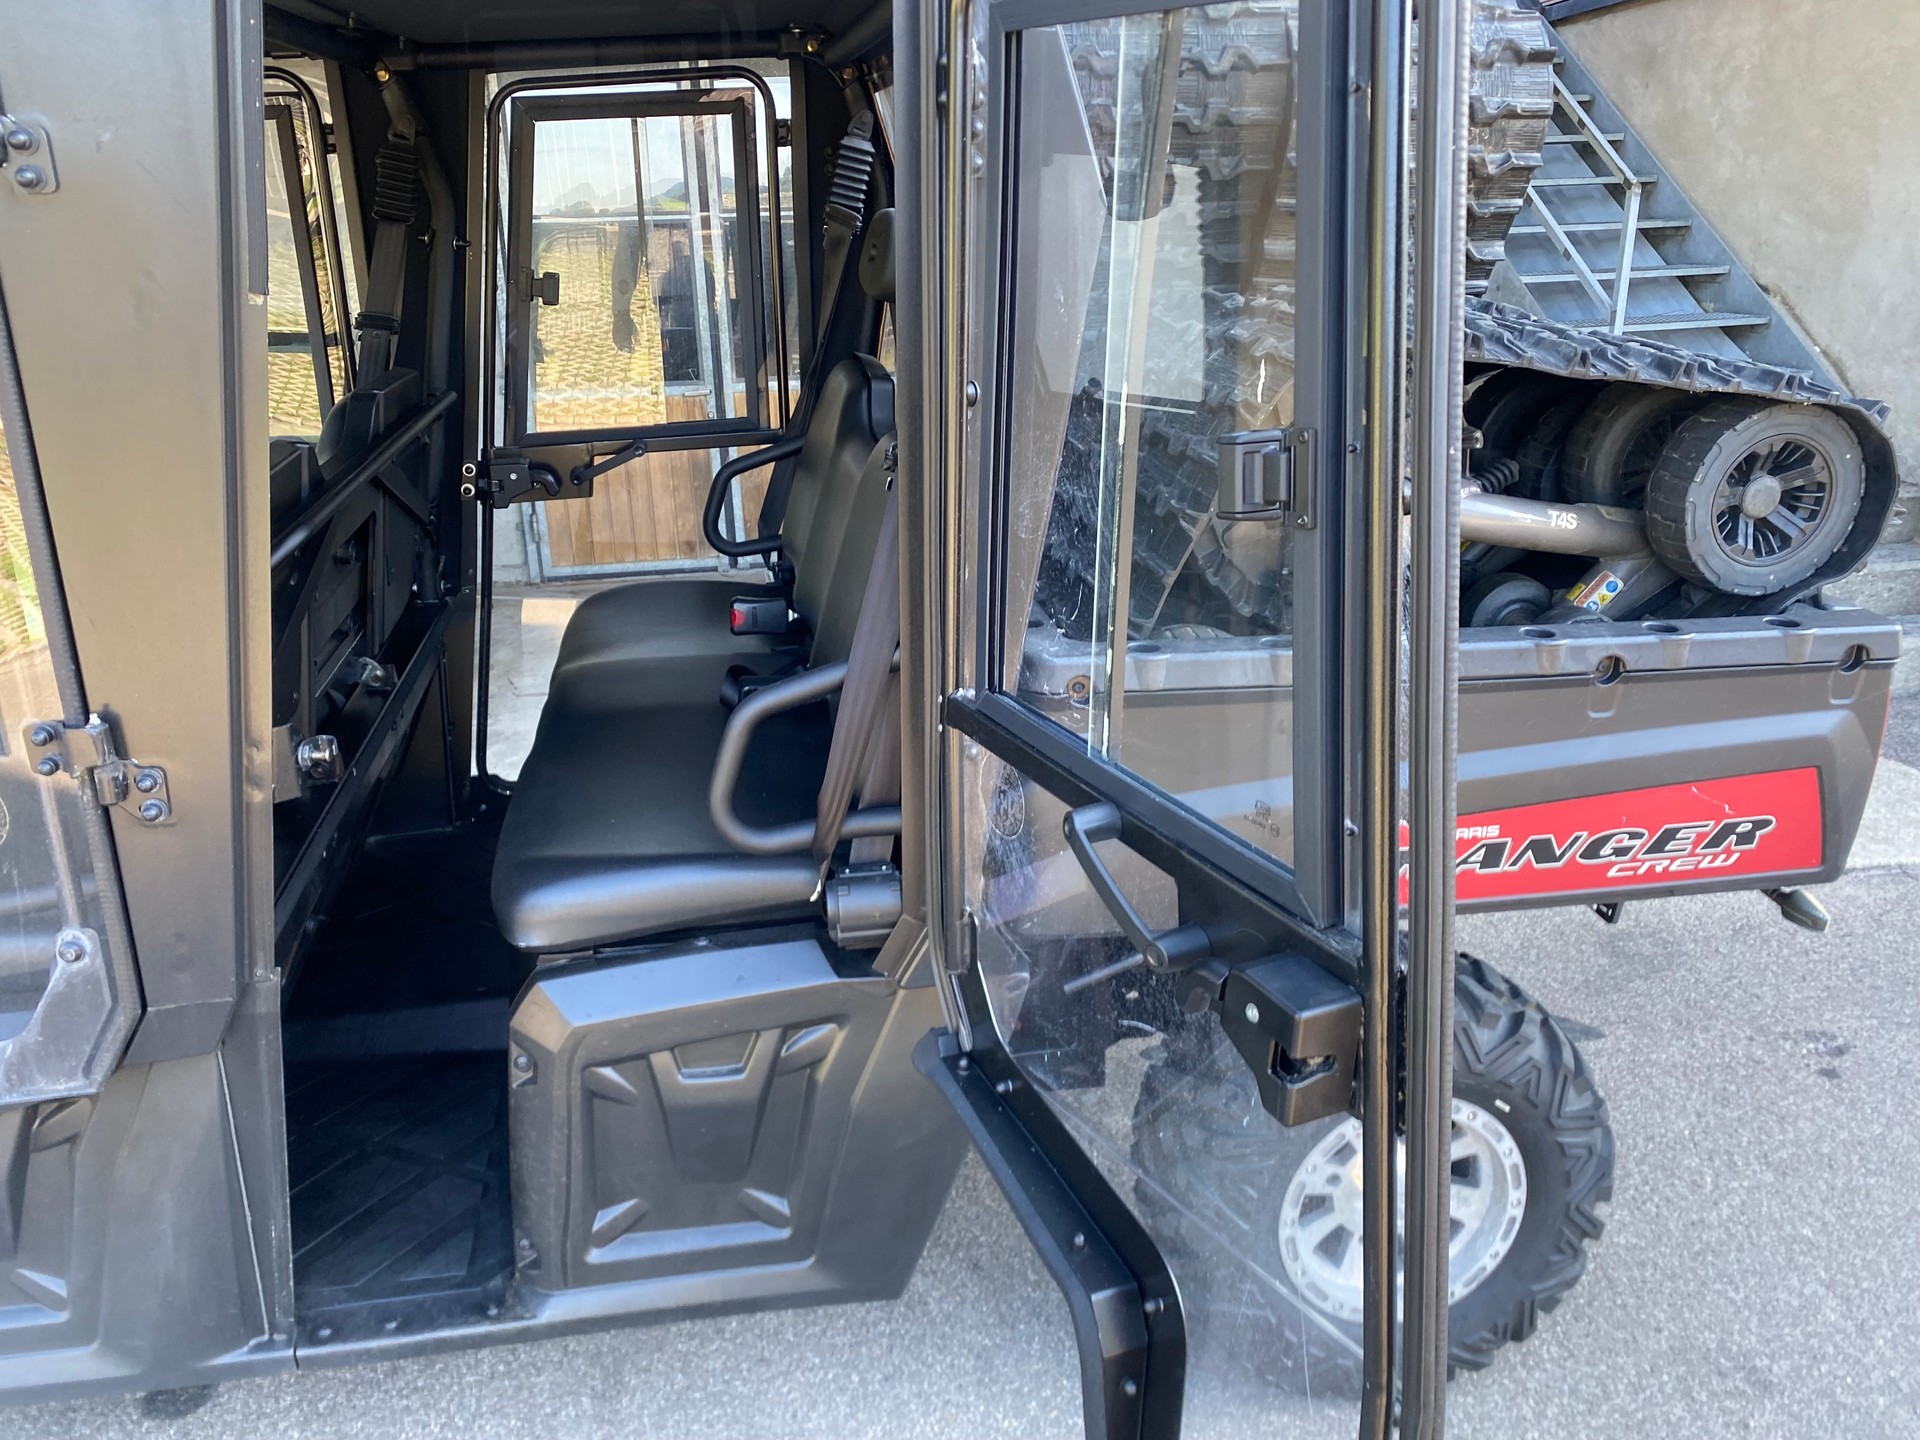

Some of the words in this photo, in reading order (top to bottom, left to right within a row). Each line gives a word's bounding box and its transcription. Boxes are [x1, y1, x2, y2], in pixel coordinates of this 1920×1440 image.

[1547, 509, 1578, 530] T4S
[1456, 825, 1501, 841] ARIS
[1456, 814, 1777, 876] ANGER
[1607, 852, 1741, 878] CREW
